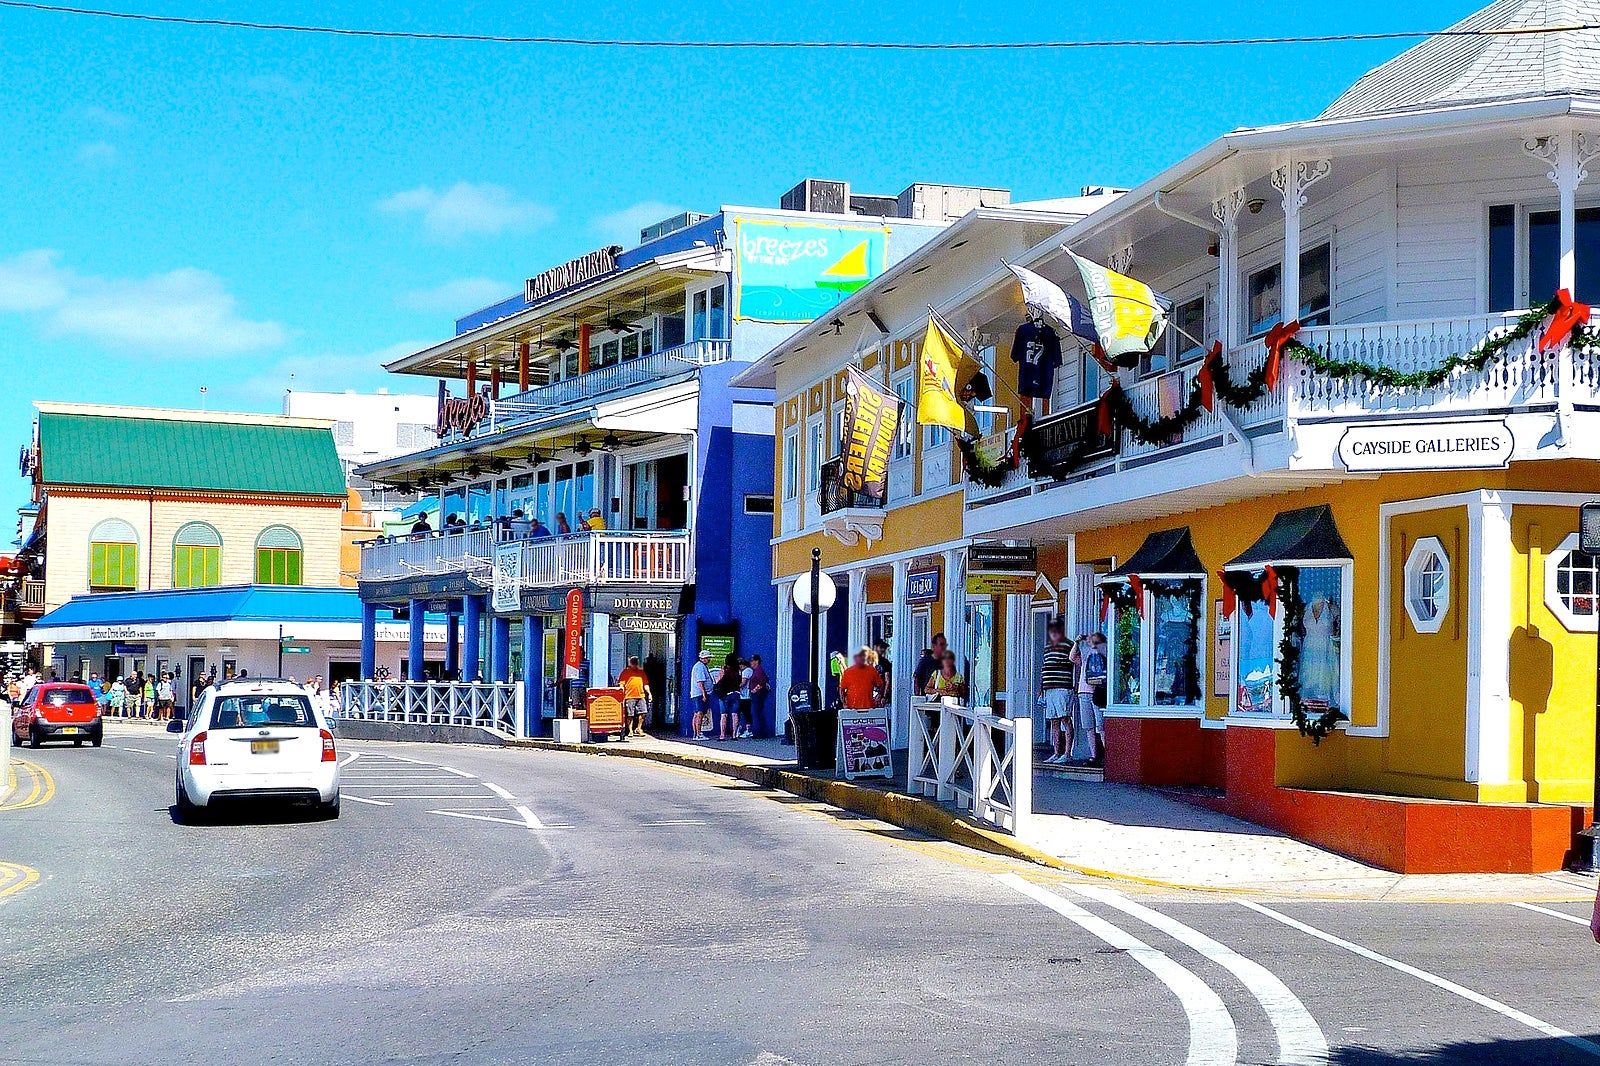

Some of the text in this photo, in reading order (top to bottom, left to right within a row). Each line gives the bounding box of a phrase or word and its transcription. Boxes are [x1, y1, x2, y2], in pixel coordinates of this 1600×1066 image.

[743, 232, 829, 259] breezes
[524, 246, 615, 304] LANDMARK
[1026, 341, 1044, 365] 27
[1352, 437, 1500, 456] CAYSIDE GALLERIES
[614, 598, 673, 609] DUTY FREE
[425, 630, 446, 640] rive
[569, 594, 580, 663] CUBAN CIGARS
[625, 620, 675, 630] LANDMARK
[846, 740, 854, 770] UPSTAIRS
